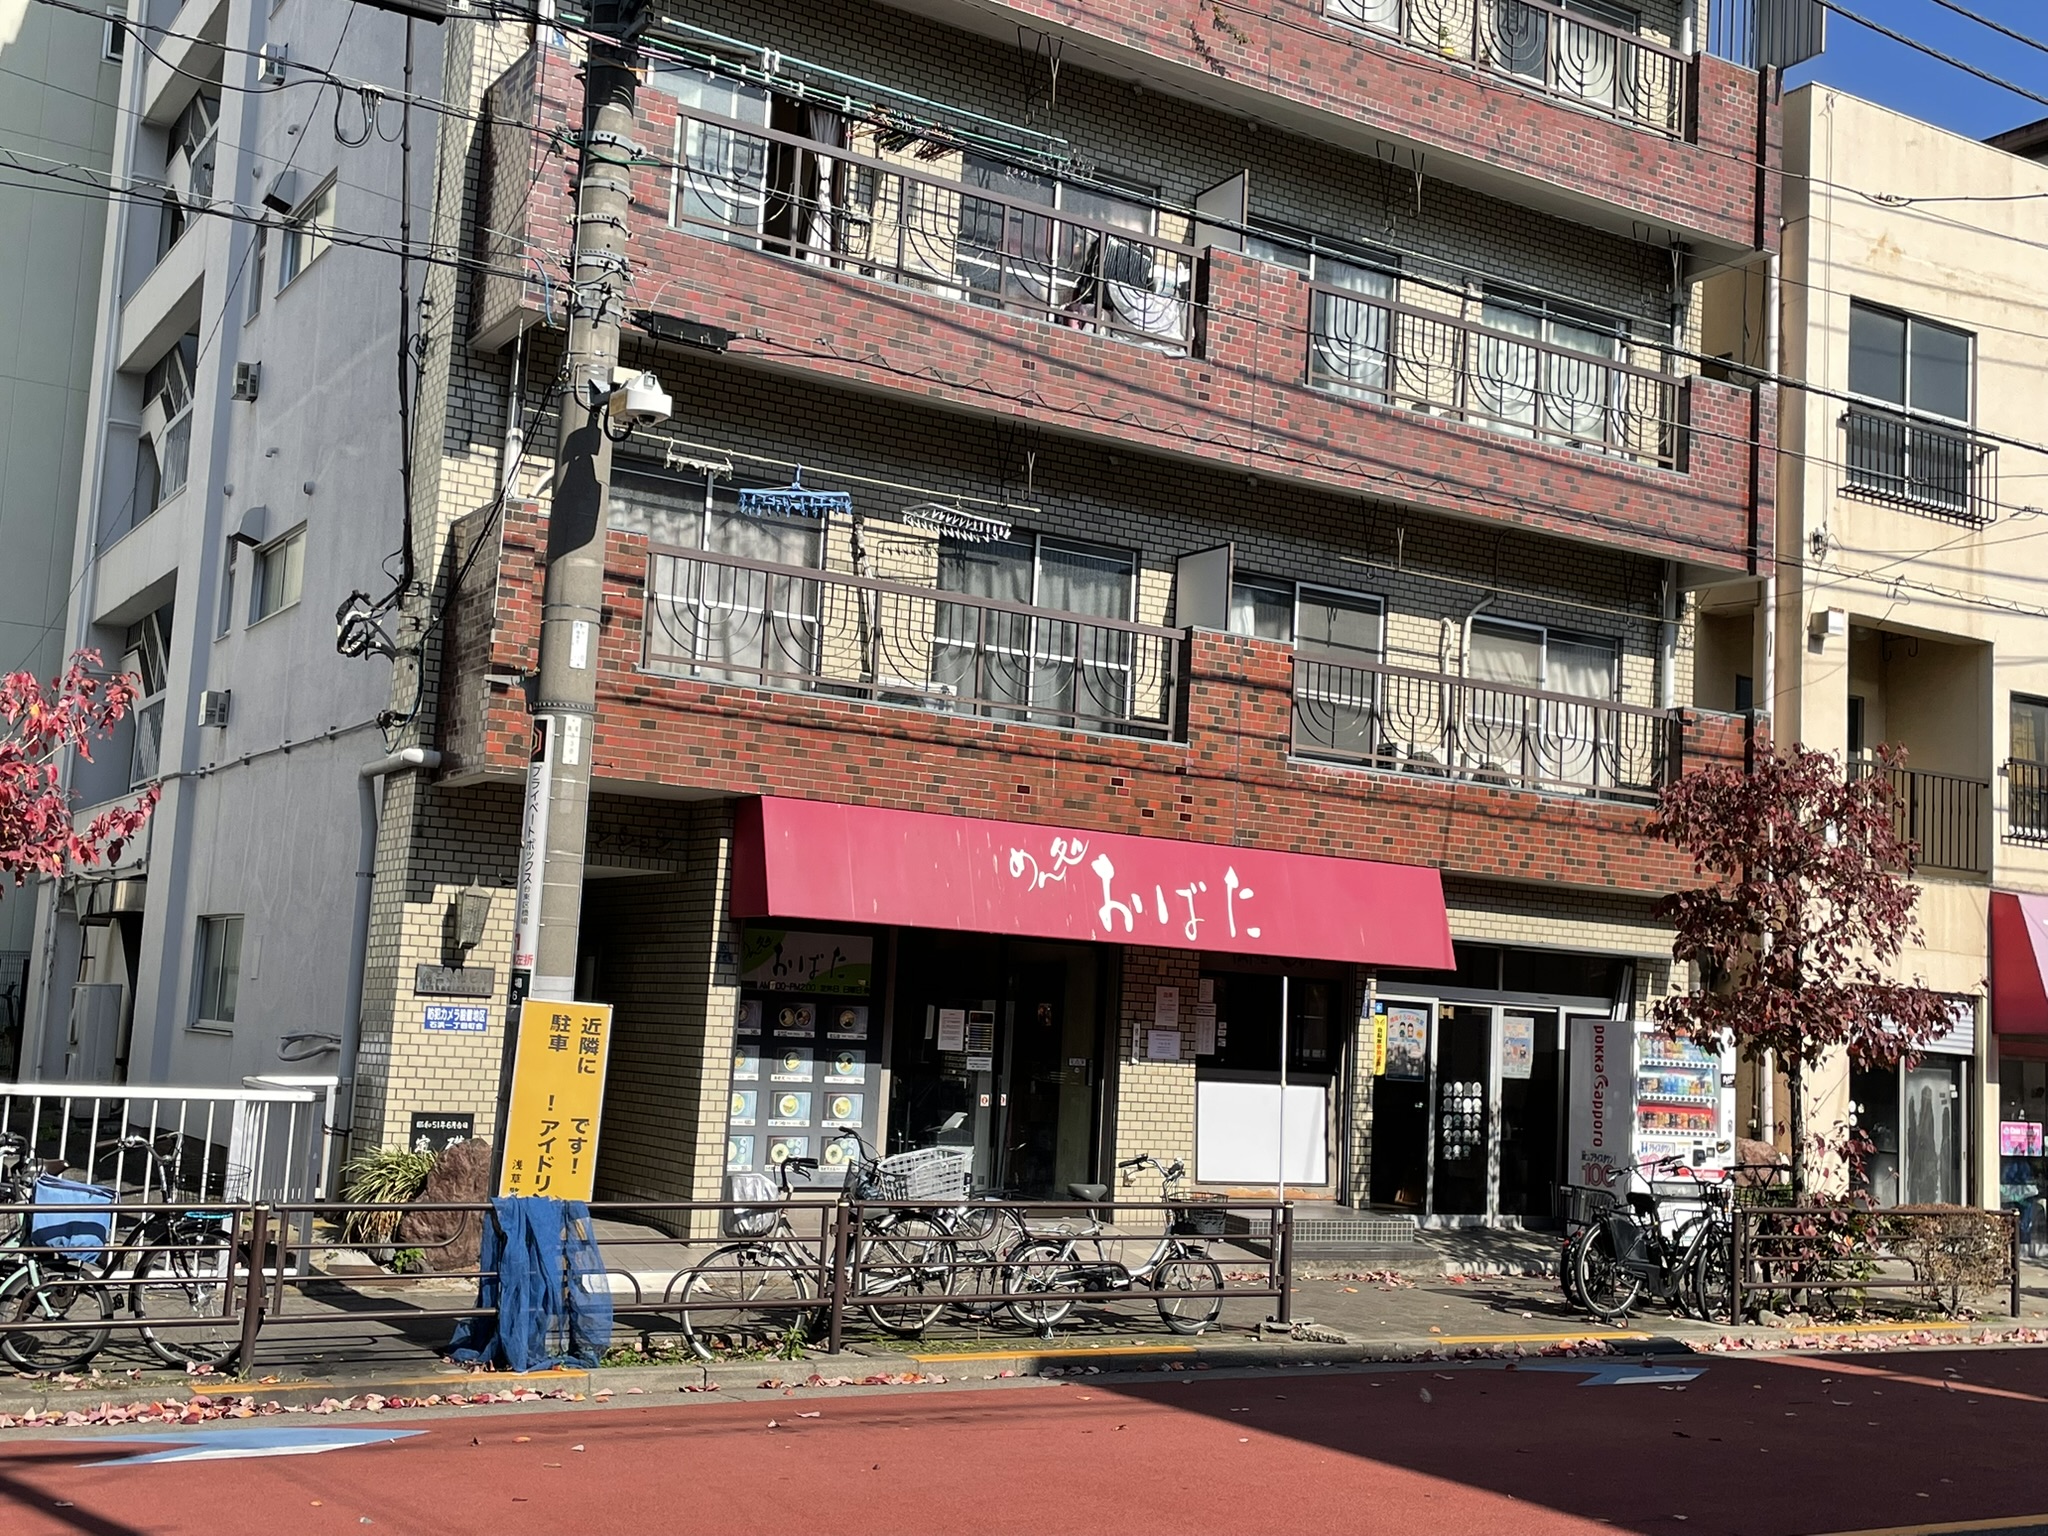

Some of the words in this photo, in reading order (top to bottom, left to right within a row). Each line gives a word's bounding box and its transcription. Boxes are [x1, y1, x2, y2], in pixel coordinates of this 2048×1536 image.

[1090, 853, 1261, 941] おばた
[513, 954, 534, 966] 左折
[547, 1013, 572, 1052] 駐車
[577, 1016, 602, 1075] 近隣に
